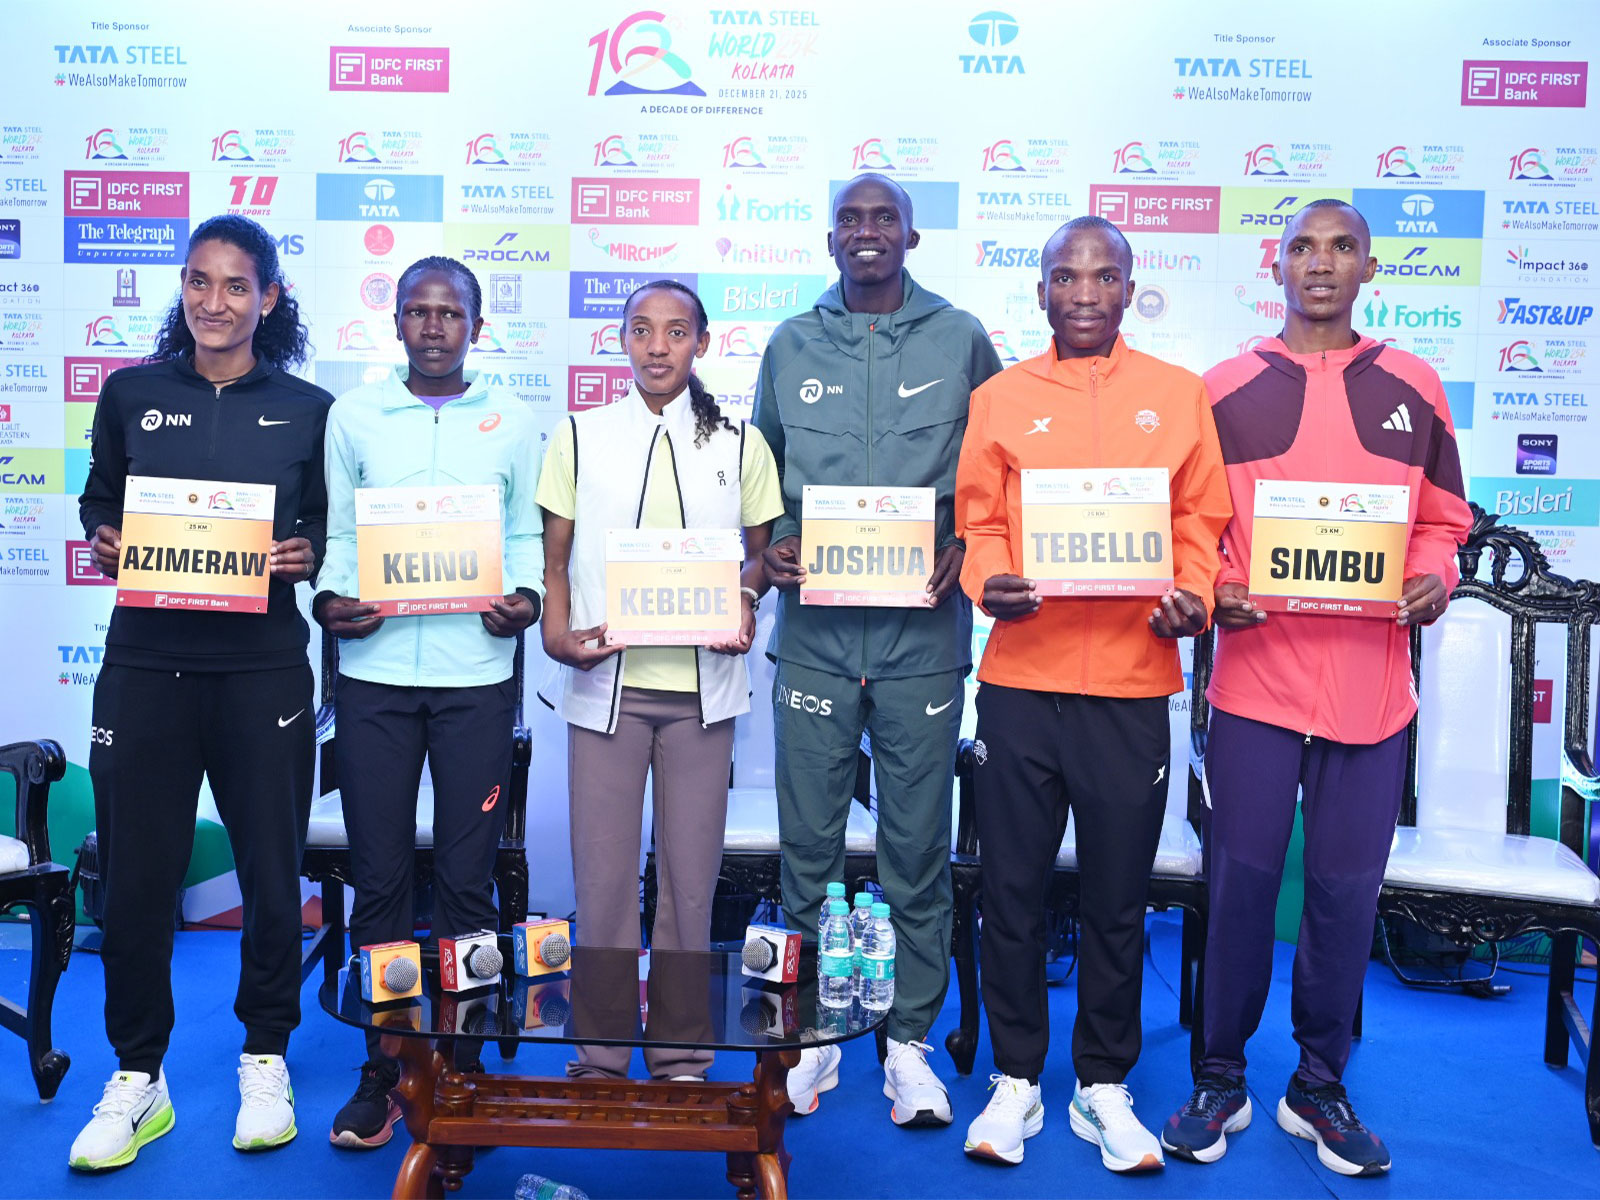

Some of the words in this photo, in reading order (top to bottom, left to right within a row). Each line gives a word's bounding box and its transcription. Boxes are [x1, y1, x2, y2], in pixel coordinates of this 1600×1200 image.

[709, 10, 763, 26] TATA
[769, 11, 820, 26] STEEL
[90, 21, 109, 31] Title
[111, 21, 150, 32] Sponsor
[347, 24, 392, 33] Associate
[394, 25, 433, 35] Sponsor
[707, 31, 777, 59] WORLD
[1213, 34, 1233, 43] Title
[1235, 34, 1276, 44] Sponsor
[1482, 38, 1528, 48] Associate
[1530, 38, 1572, 49] Sponsor
[54, 45, 119, 64] TATA
[126, 46, 188, 65] STEEL
[370, 58, 403, 71] IDFC
[405, 58, 443, 72] FIRST
[731, 61, 795, 80] KOLKATA
[958, 55, 1026, 75] TATA
[1174, 58, 1242, 77] TATA
[1249, 58, 1313, 79] STEEL
[54, 73, 188, 88] #WeAlsoMakeTomorrow
[370, 73, 403, 86] Bank
[1504, 72, 1538, 85] IDFC
[1540, 73, 1581, 86] FIRST
[718, 89, 766, 99] DECEMBER
[769, 89, 782, 100] 21,
[785, 90, 808, 100] 2025
[1172, 86, 1312, 103] #WeAlsoMakeTomorrow
[1504, 87, 1538, 101] Bank
[640, 106, 648, 115] A
[649, 106, 689, 115] DECADE
[690, 106, 704, 115] OF
[705, 106, 764, 116] DIFFERENCE
[1556, 147, 1576, 155] TATA
[5, 178, 48, 193] STEEL
[107, 182, 140, 195] IDFC
[143, 183, 183, 197] FIRST
[461, 185, 506, 199] TATA
[511, 186, 554, 200] STEEL
[615, 190, 649, 203] IDFC
[651, 190, 693, 204] FIRST
[976, 192, 1023, 206] TATA
[1027, 193, 1072, 207] STEEL
[107, 198, 142, 211] Bank
[359, 204, 401, 217] TATA
[460, 203, 554, 215] #WeAlsoMakeTomorrow
[746, 198, 813, 222] Fortis
[1133, 197, 1167, 210] IDFC
[1170, 198, 1213, 212] FIRST
[1502, 201, 1550, 215] TATA
[1555, 202, 1600, 216] STEEL
[242, 208, 272, 217] SPORTS
[615, 205, 651, 219] Bank
[976, 211, 1071, 222] #WeAlsoMakeTomorrow
[1133, 212, 1169, 226] Bank
[1240, 213, 1293, 226] PROC
[1502, 220, 1599, 232] #WeAlsoMakeTomorrow
[78, 222, 104, 241] The
[106, 222, 175, 243] Telegraph
[1395, 220, 1439, 234] TATA
[77, 249, 176, 259] Unputdownable
[462, 249, 551, 262] PROCAM
[609, 242, 662, 262] MIRCHI
[732, 243, 812, 264] initium
[978, 240, 1041, 268] FAST&
[1133, 249, 1201, 271] nitium
[1518, 258, 1565, 273] Impact
[584, 277, 611, 294] The
[1518, 275, 1589, 284] FOUNDATION
[722, 281, 799, 313] Bisleri
[1255, 300, 1285, 320] MIR
[1394, 304, 1462, 328] Fortis
[1500, 297, 1594, 326] FAST&UP
[6, 365, 48, 378] STEEL
[508, 373, 552, 387] STEEL
[826, 385, 844, 395] NN
[1492, 392, 1539, 406] TATA
[1544, 393, 1589, 407] STEEL
[165, 414, 192, 427] NN
[1491, 411, 1588, 423] #WeAlsoMakeTomorrow
[1522, 438, 1553, 447] SONY
[1523, 459, 1551, 467] SPORTS
[1494, 486, 1573, 515] Bisleri
[1030, 531, 1163, 563] TEBELLO
[7, 548, 49, 561] STEEL
[123, 545, 267, 577] AZIMERAW
[808, 545, 927, 576] JOSHUA
[382, 550, 479, 585] KEINO
[1269, 546, 1386, 585] SIMBU
[1075, 584, 1093, 593] IDFC
[1094, 584, 1116, 593] FIRST
[1117, 584, 1136, 592] Bank
[168, 597, 186, 606] IDFC
[187, 598, 210, 607] FIRST
[211, 600, 229, 608] Bank
[410, 603, 428, 612] IDFC
[428, 602, 450, 611] FIRST
[450, 601, 468, 610] Bank
[620, 586, 729, 617] KEBEDE
[1300, 602, 1319, 611] IDFC
[1320, 603, 1342, 611] FIRST
[1343, 604, 1363, 612] Bank
[57, 646, 105, 664] TAT
[778, 683, 833, 717] INEOS
[91, 726, 114, 747] EOS
